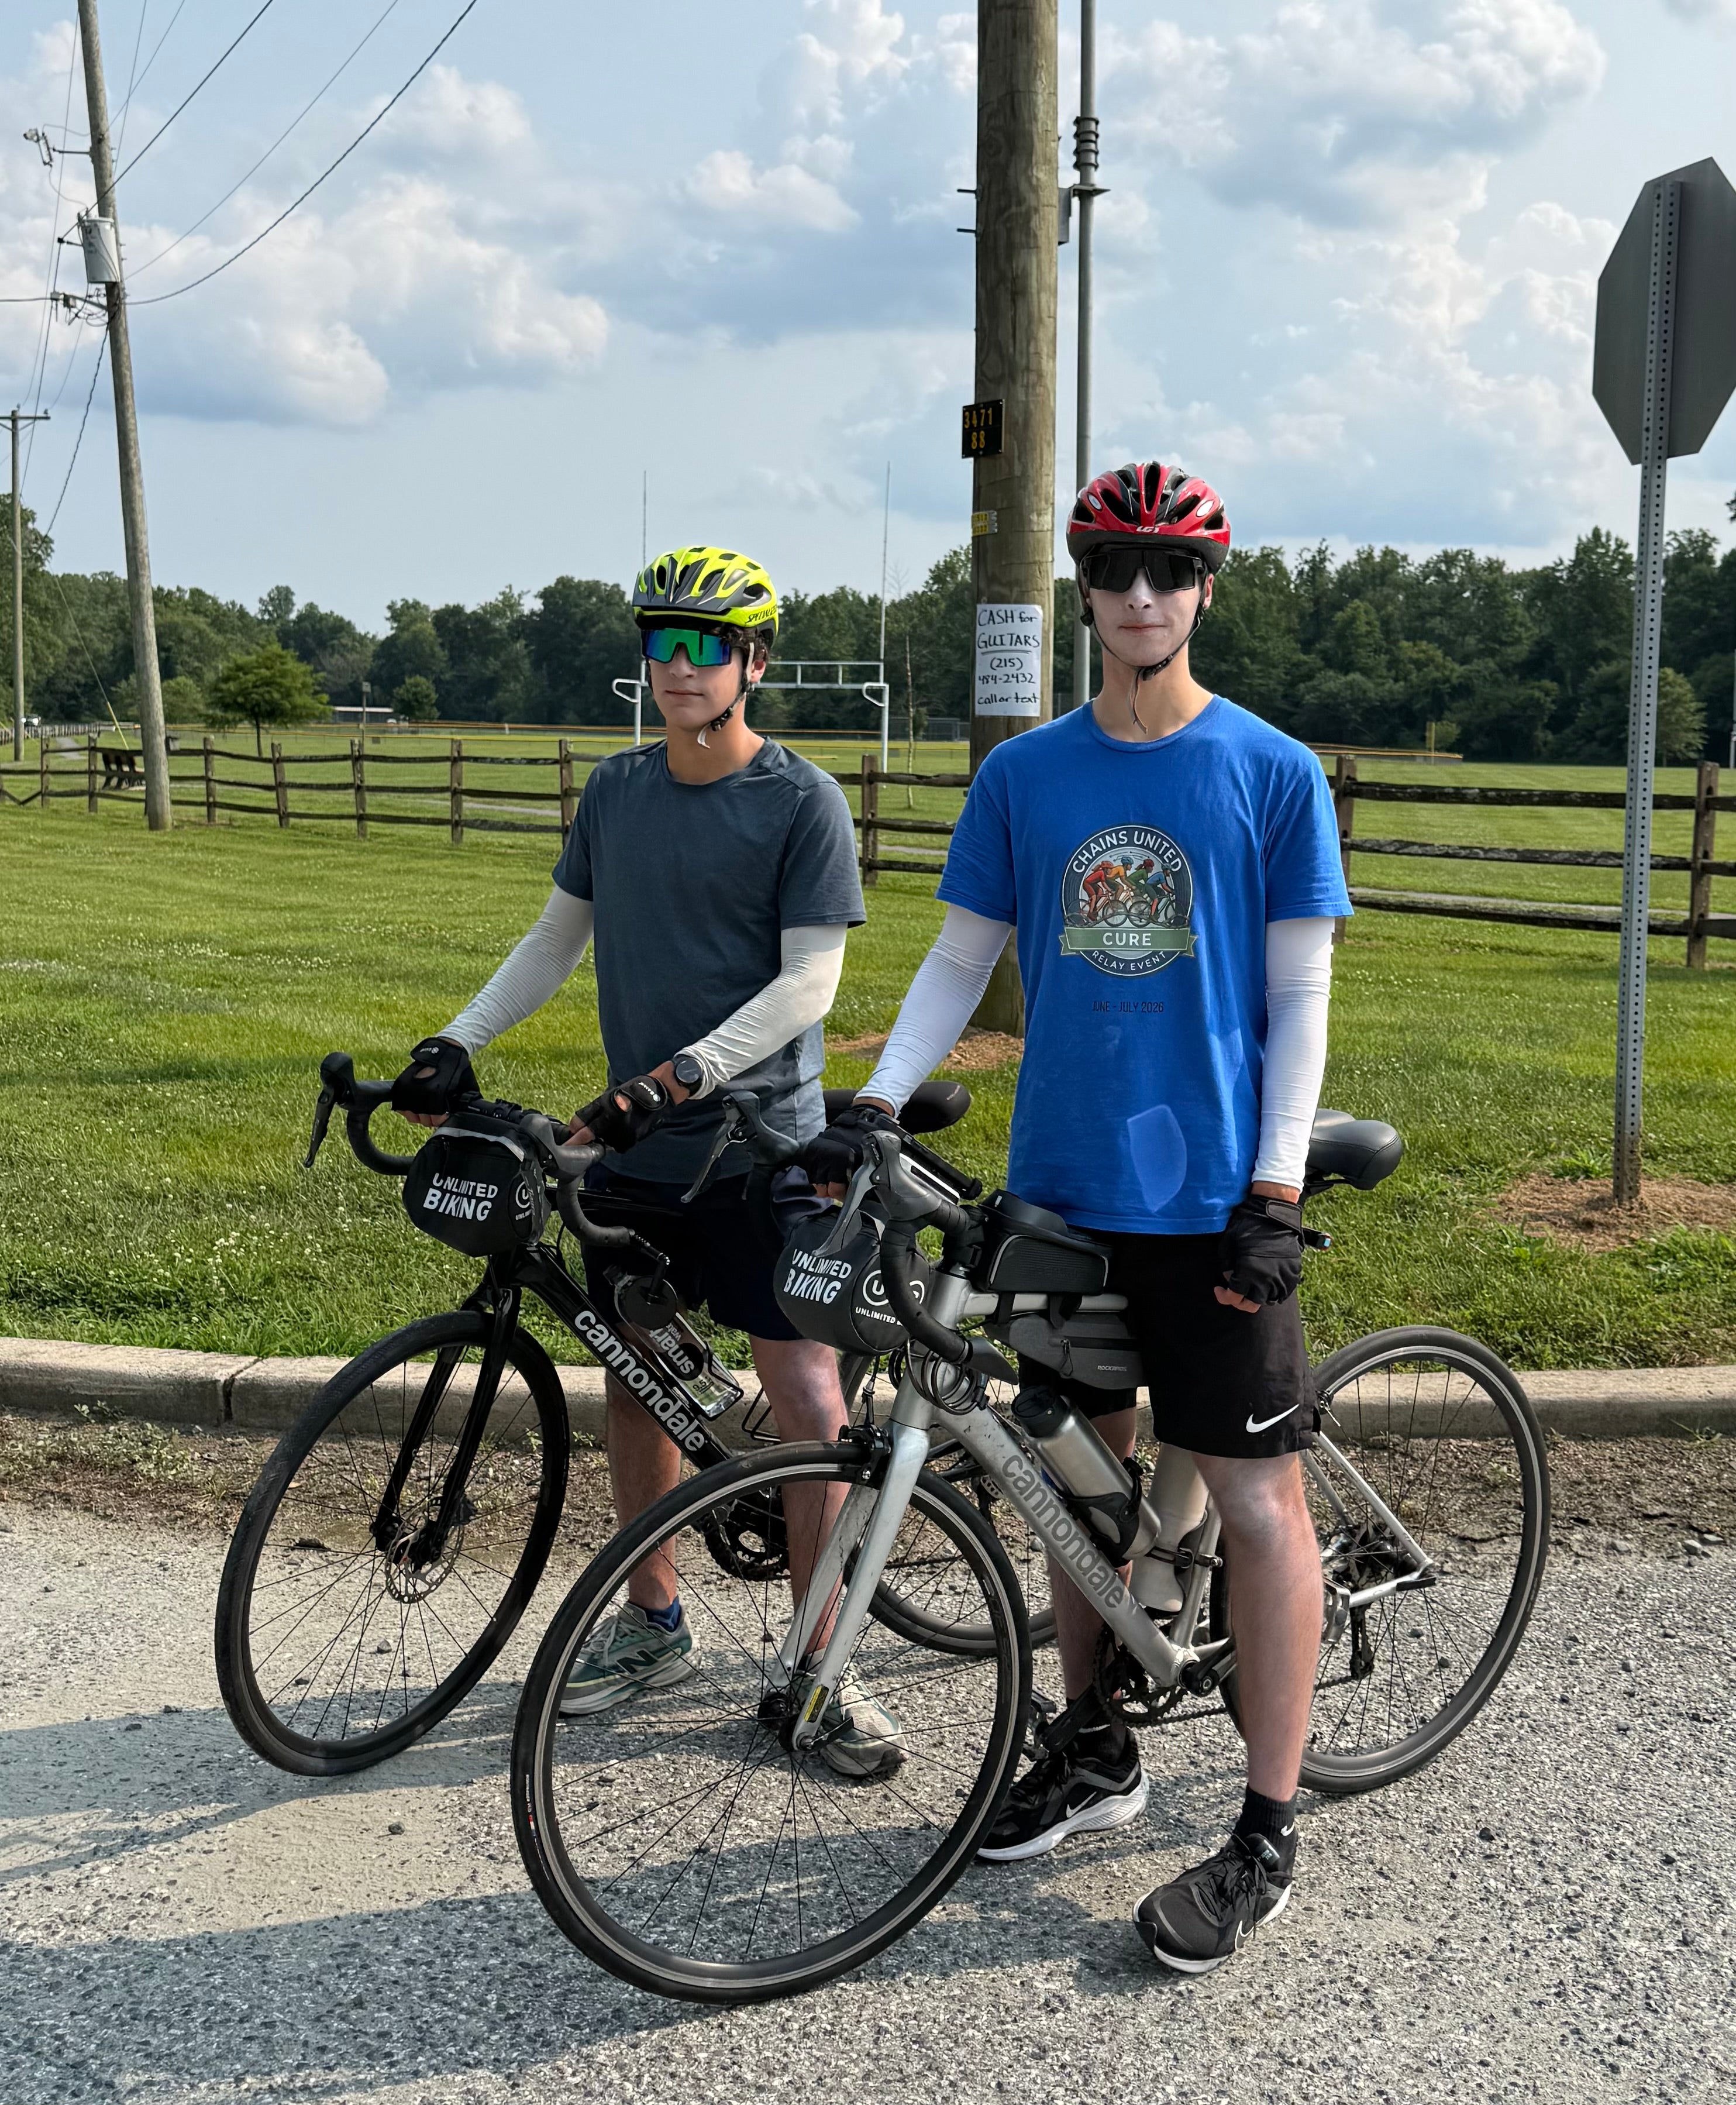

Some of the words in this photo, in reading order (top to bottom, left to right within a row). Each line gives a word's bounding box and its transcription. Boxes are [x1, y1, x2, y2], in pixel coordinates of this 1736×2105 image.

[964, 407, 992, 428] 3471
[972, 431, 985, 449] 88
[978, 610, 1014, 627] CASH
[1018, 611, 1038, 623] for
[977, 632, 1039, 649] GUITARS
[990, 657, 1023, 670] (215)
[978, 693, 997, 704] call
[1073, 831, 1128, 873] CHAINS
[1134, 831, 1182, 872] UNITED
[1103, 933, 1152, 946] CURE
[1093, 951, 1125, 971] RELAY
[1131, 951, 1166, 971] EVENT
[1092, 1001, 1110, 1012] JUNE
[1118, 1001, 1139, 1012] JULY
[1141, 1002, 1164, 1013] 2026
[423, 1188, 492, 1221] BIKING
[784, 1268, 842, 1304] BIKING
[855, 1306, 896, 1323] UNLIMITED
[649, 1327, 695, 1374] smart
[574, 1311, 705, 1452] cannondale
[1001, 1455, 1124, 1608] cannondale
